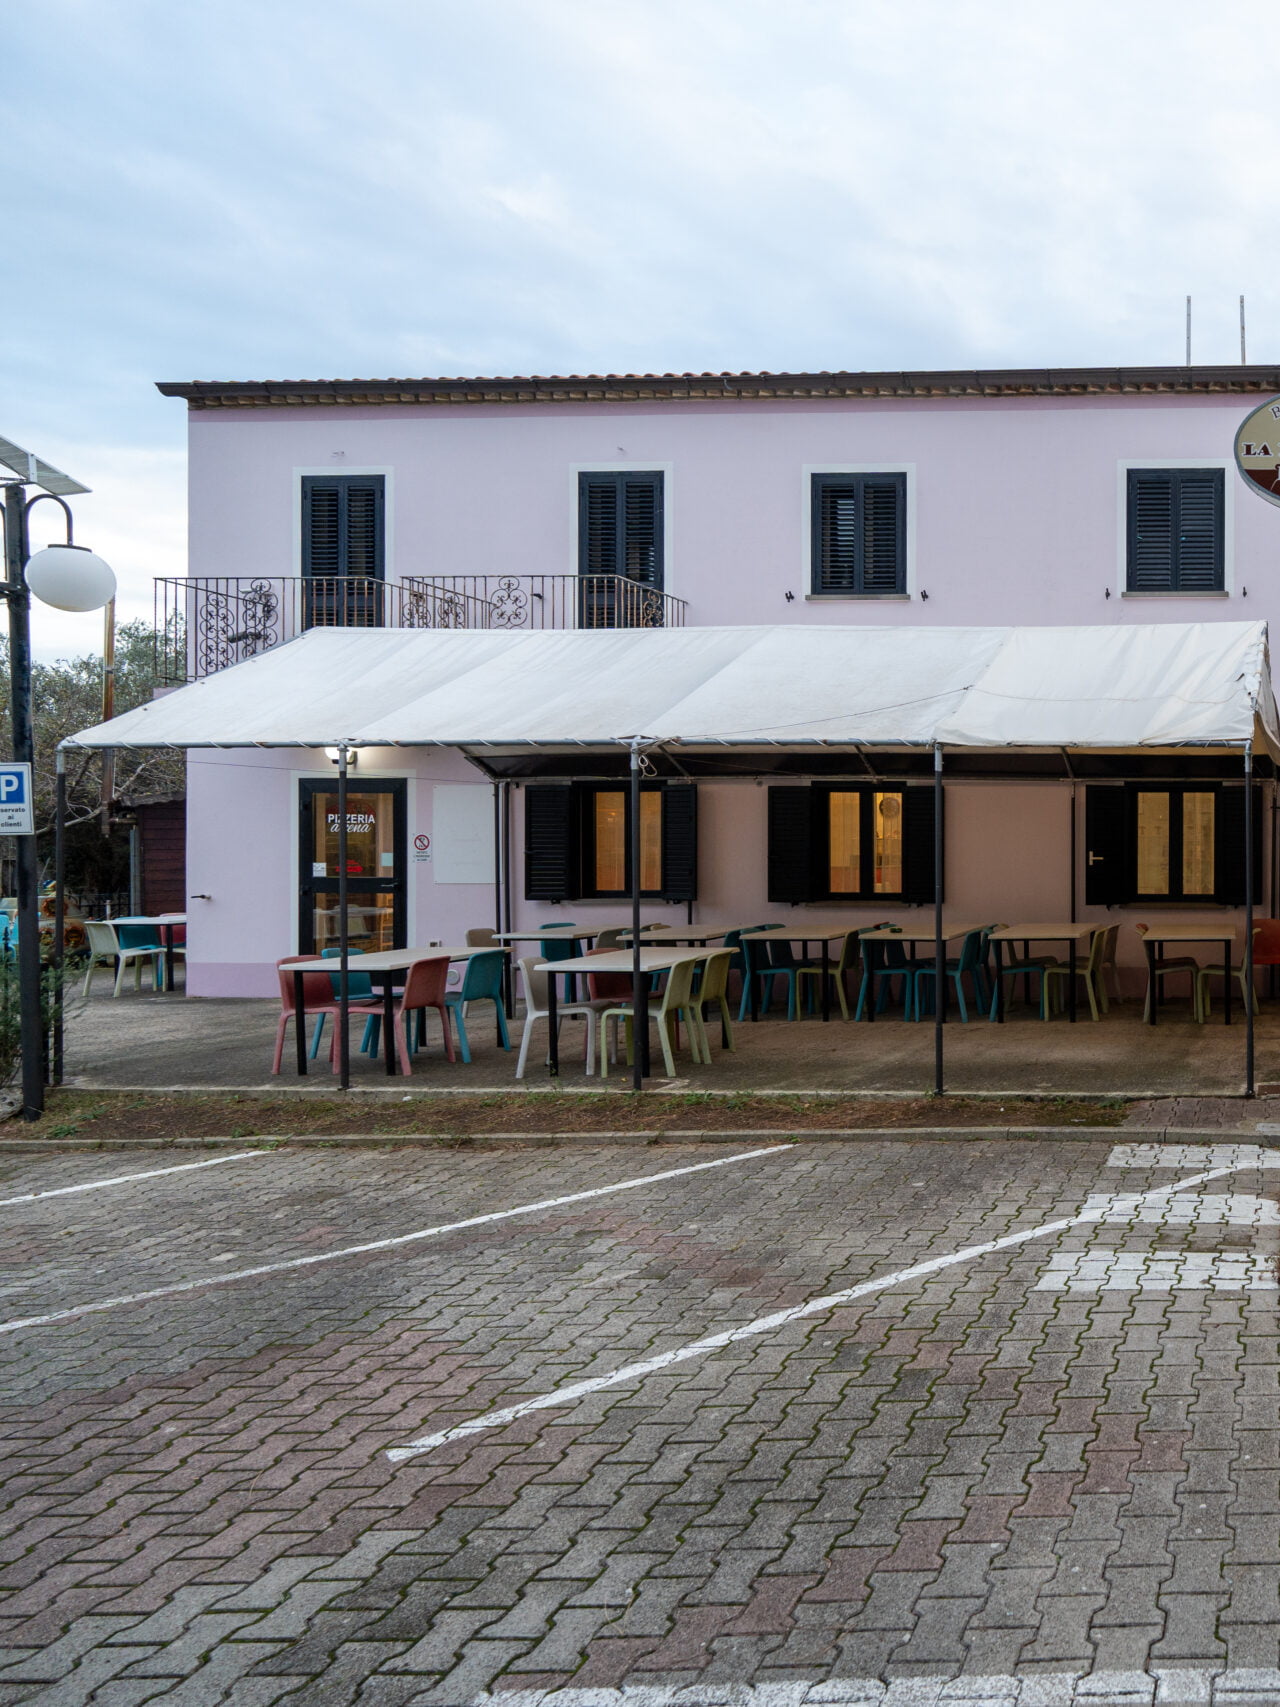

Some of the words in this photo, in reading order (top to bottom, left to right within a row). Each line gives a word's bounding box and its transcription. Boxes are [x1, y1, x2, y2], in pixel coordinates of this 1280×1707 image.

[1243, 443, 1271, 456] LA
[1, 775, 19, 800] P
[331, 823, 340, 832] a
